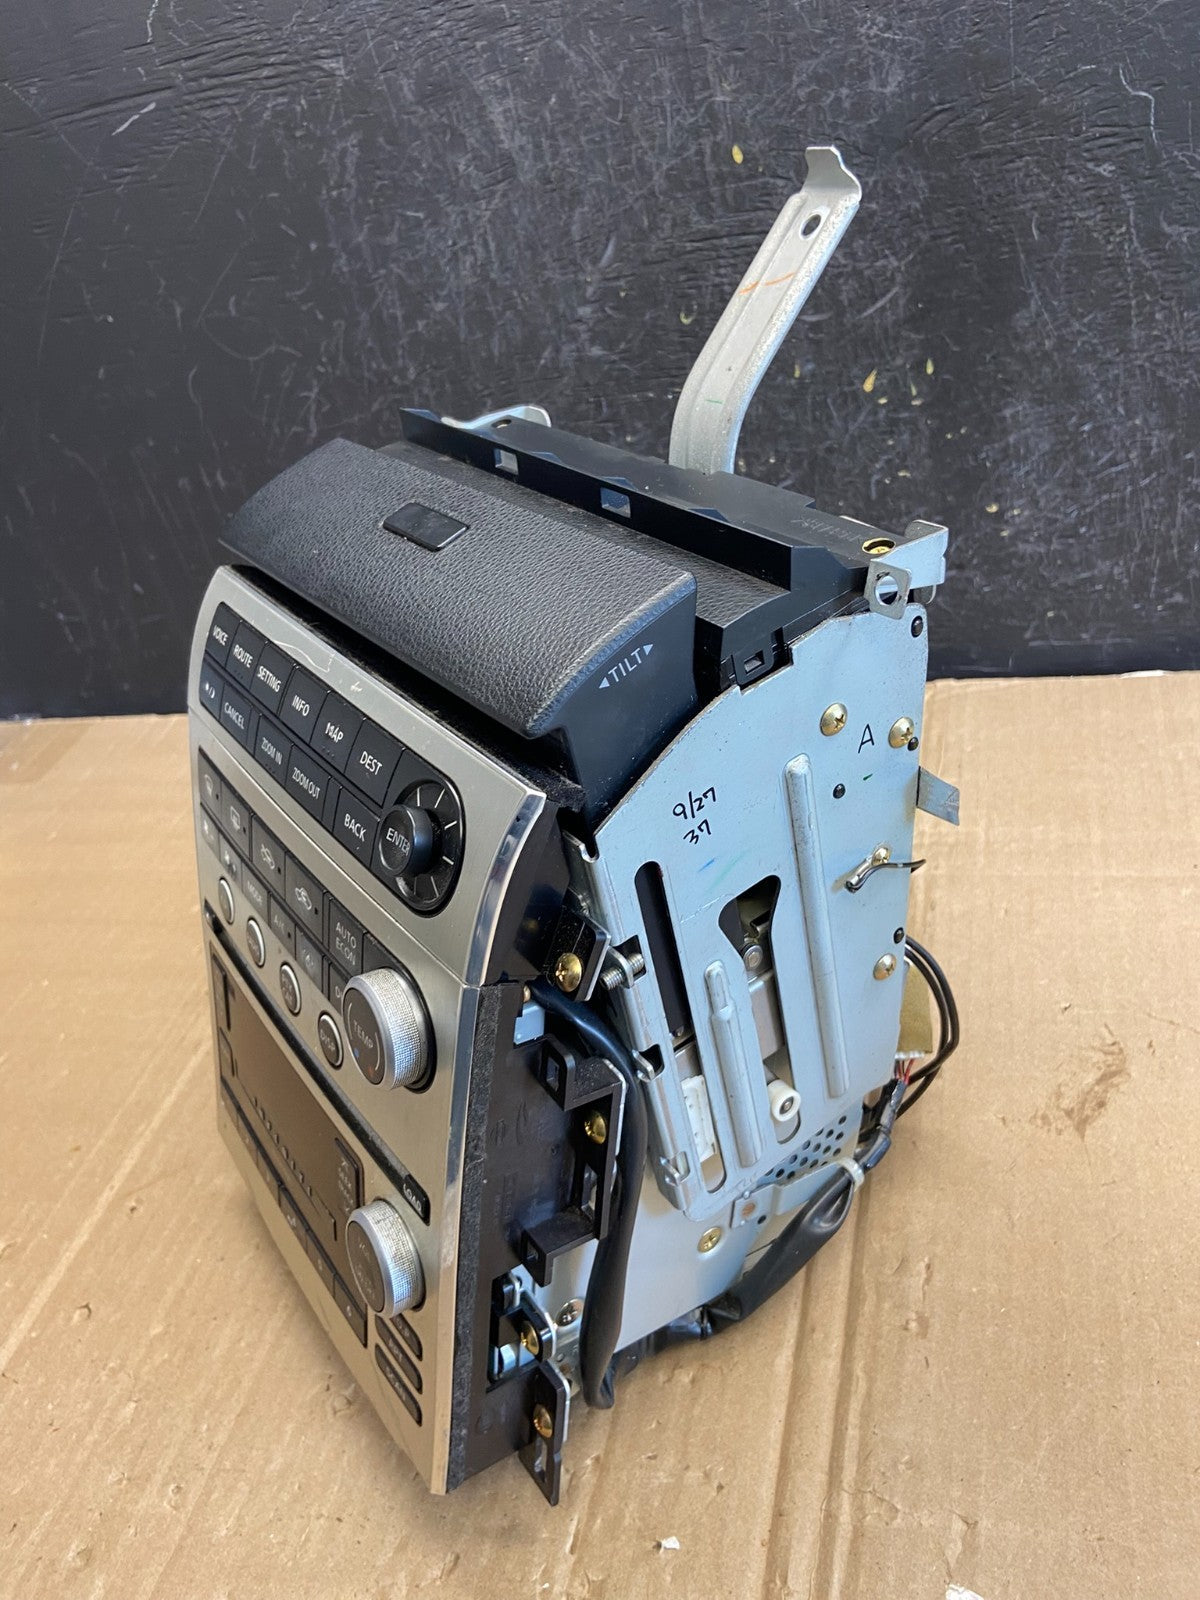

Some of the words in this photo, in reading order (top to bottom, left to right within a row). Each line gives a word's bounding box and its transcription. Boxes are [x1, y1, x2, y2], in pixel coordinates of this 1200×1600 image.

[232, 644, 254, 669] ROUTE
[608, 648, 643, 682] TILT
[257, 665, 281, 693] SETTING
[224, 702, 245, 730] CANCEL
[291, 695, 310, 717] INFO
[325, 722, 343, 744] MAP
[857, 723, 875, 754] A
[261, 737, 276, 759] ZOOM
[360, 750, 383, 776] DEST
[292, 766, 310, 790] ZOOM
[308, 781, 321, 800] OUT
[672, 786, 718, 821] 9/27
[344, 813, 366, 842] BACK
[683, 818, 713, 845] 37
[386, 827, 411, 857] ENTER
[335, 921, 357, 948] AUTO
[335, 936, 356, 966] ECON
[353, 1019, 374, 1049] TEMP
[402, 1182, 423, 1219] LOAD
